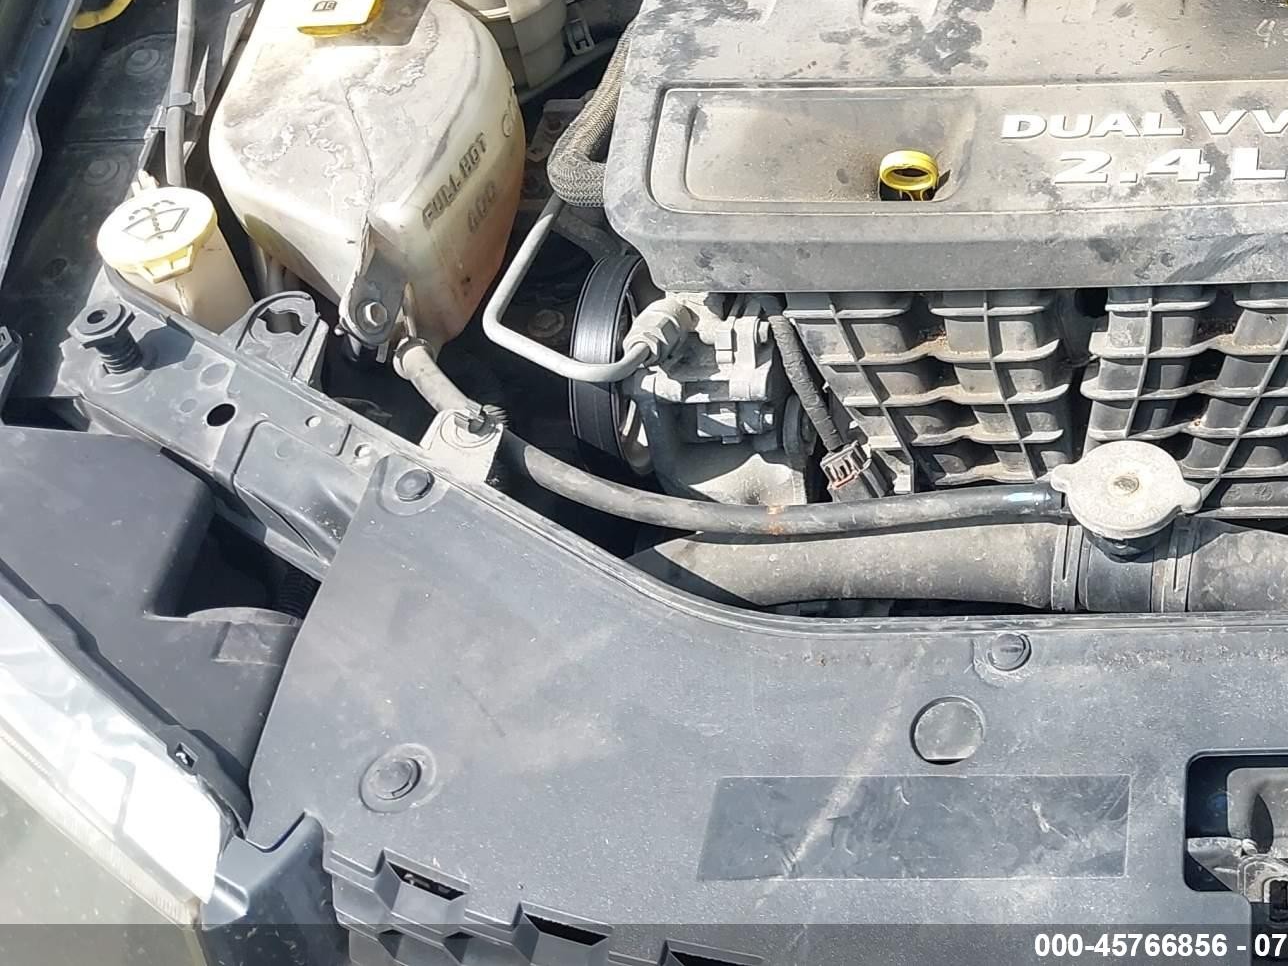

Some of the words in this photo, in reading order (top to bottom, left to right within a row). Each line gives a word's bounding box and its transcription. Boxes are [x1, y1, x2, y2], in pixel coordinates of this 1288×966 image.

[1000, 113, 1185, 140] DUAL
[421, 173, 461, 232] FULL
[458, 132, 488, 179] HOT
